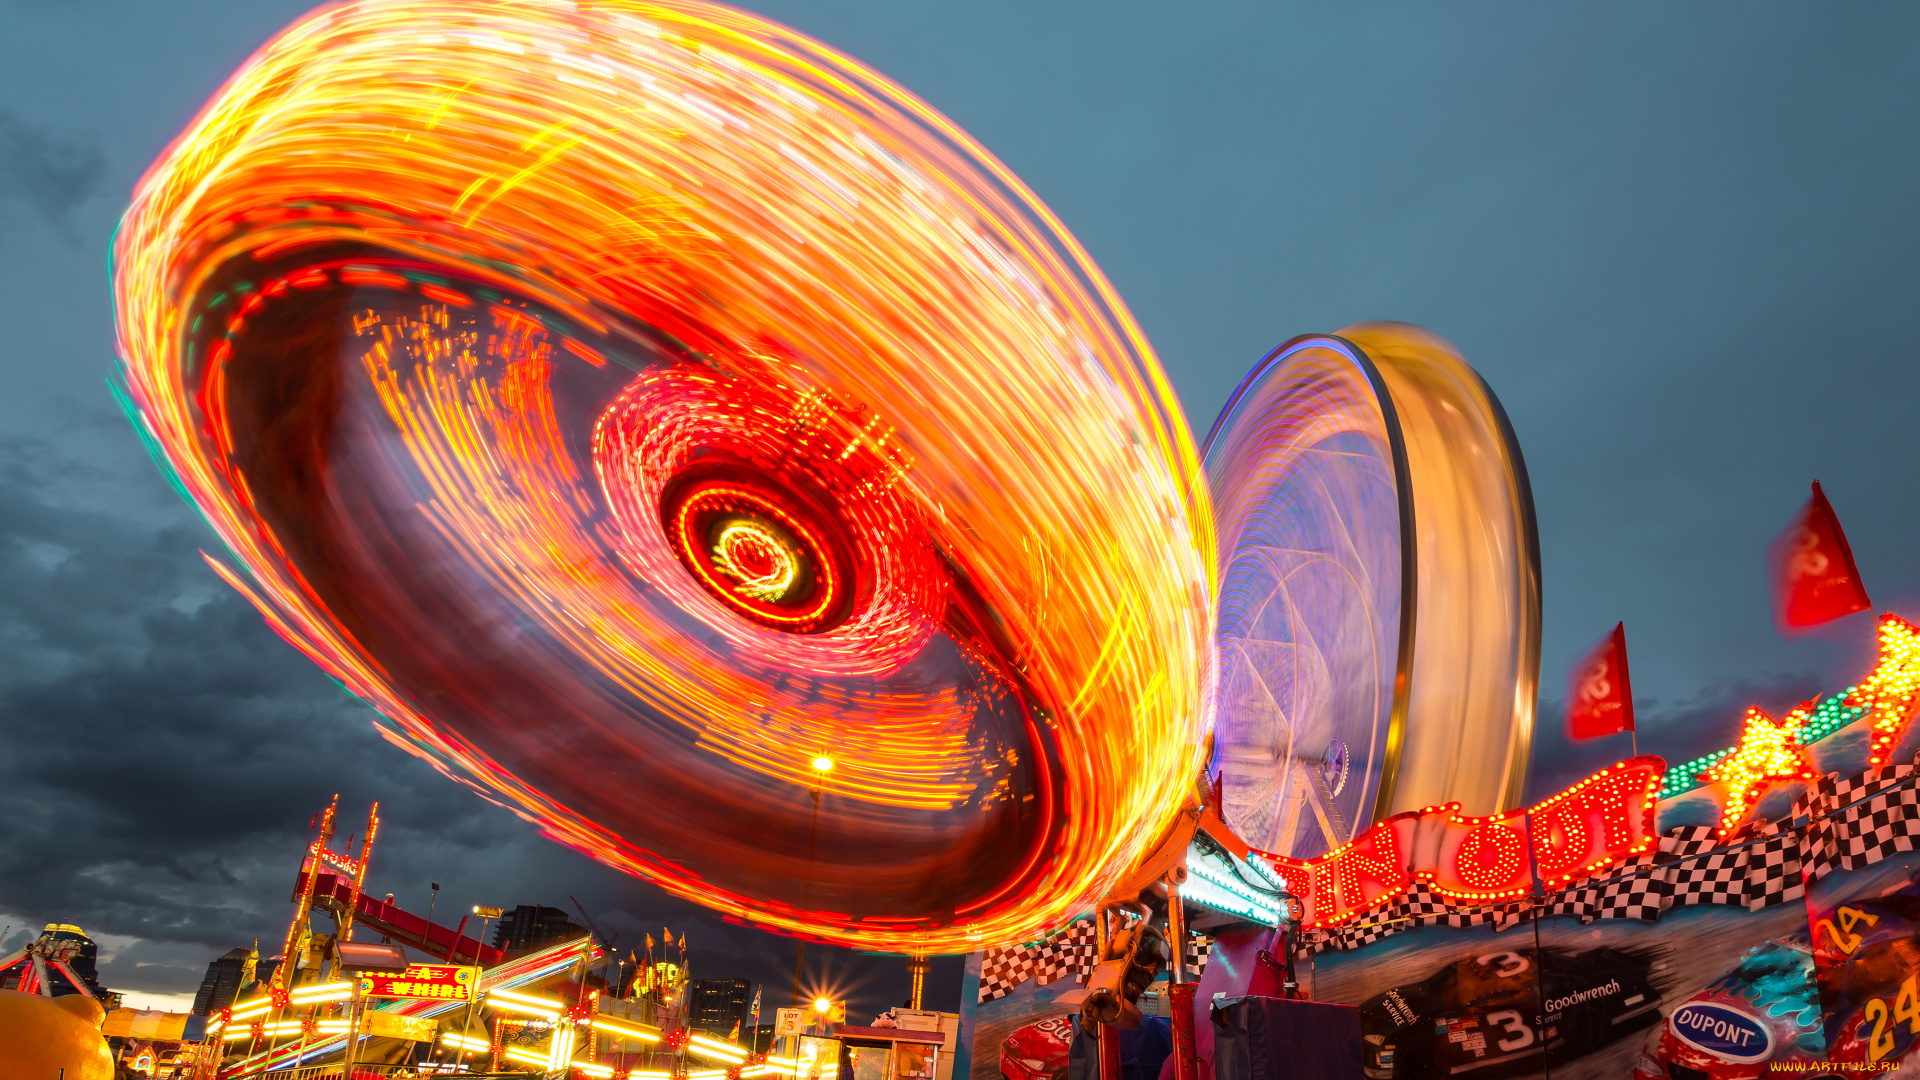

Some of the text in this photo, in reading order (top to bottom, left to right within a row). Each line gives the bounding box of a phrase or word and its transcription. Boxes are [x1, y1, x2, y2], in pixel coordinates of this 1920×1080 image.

[1455, 769, 1650, 888] OUT
[1814, 905, 1881, 956] 24
[1477, 951, 1530, 979] 3
[392, 982, 465, 998] WHIRL
[1545, 978, 1621, 1013] Goodwrench
[1383, 999, 1405, 1027] SERVICE
[1486, 1009, 1534, 1052] 3
[1678, 1009, 1756, 1047] DUPONT
[1865, 973, 1920, 1064] 24
